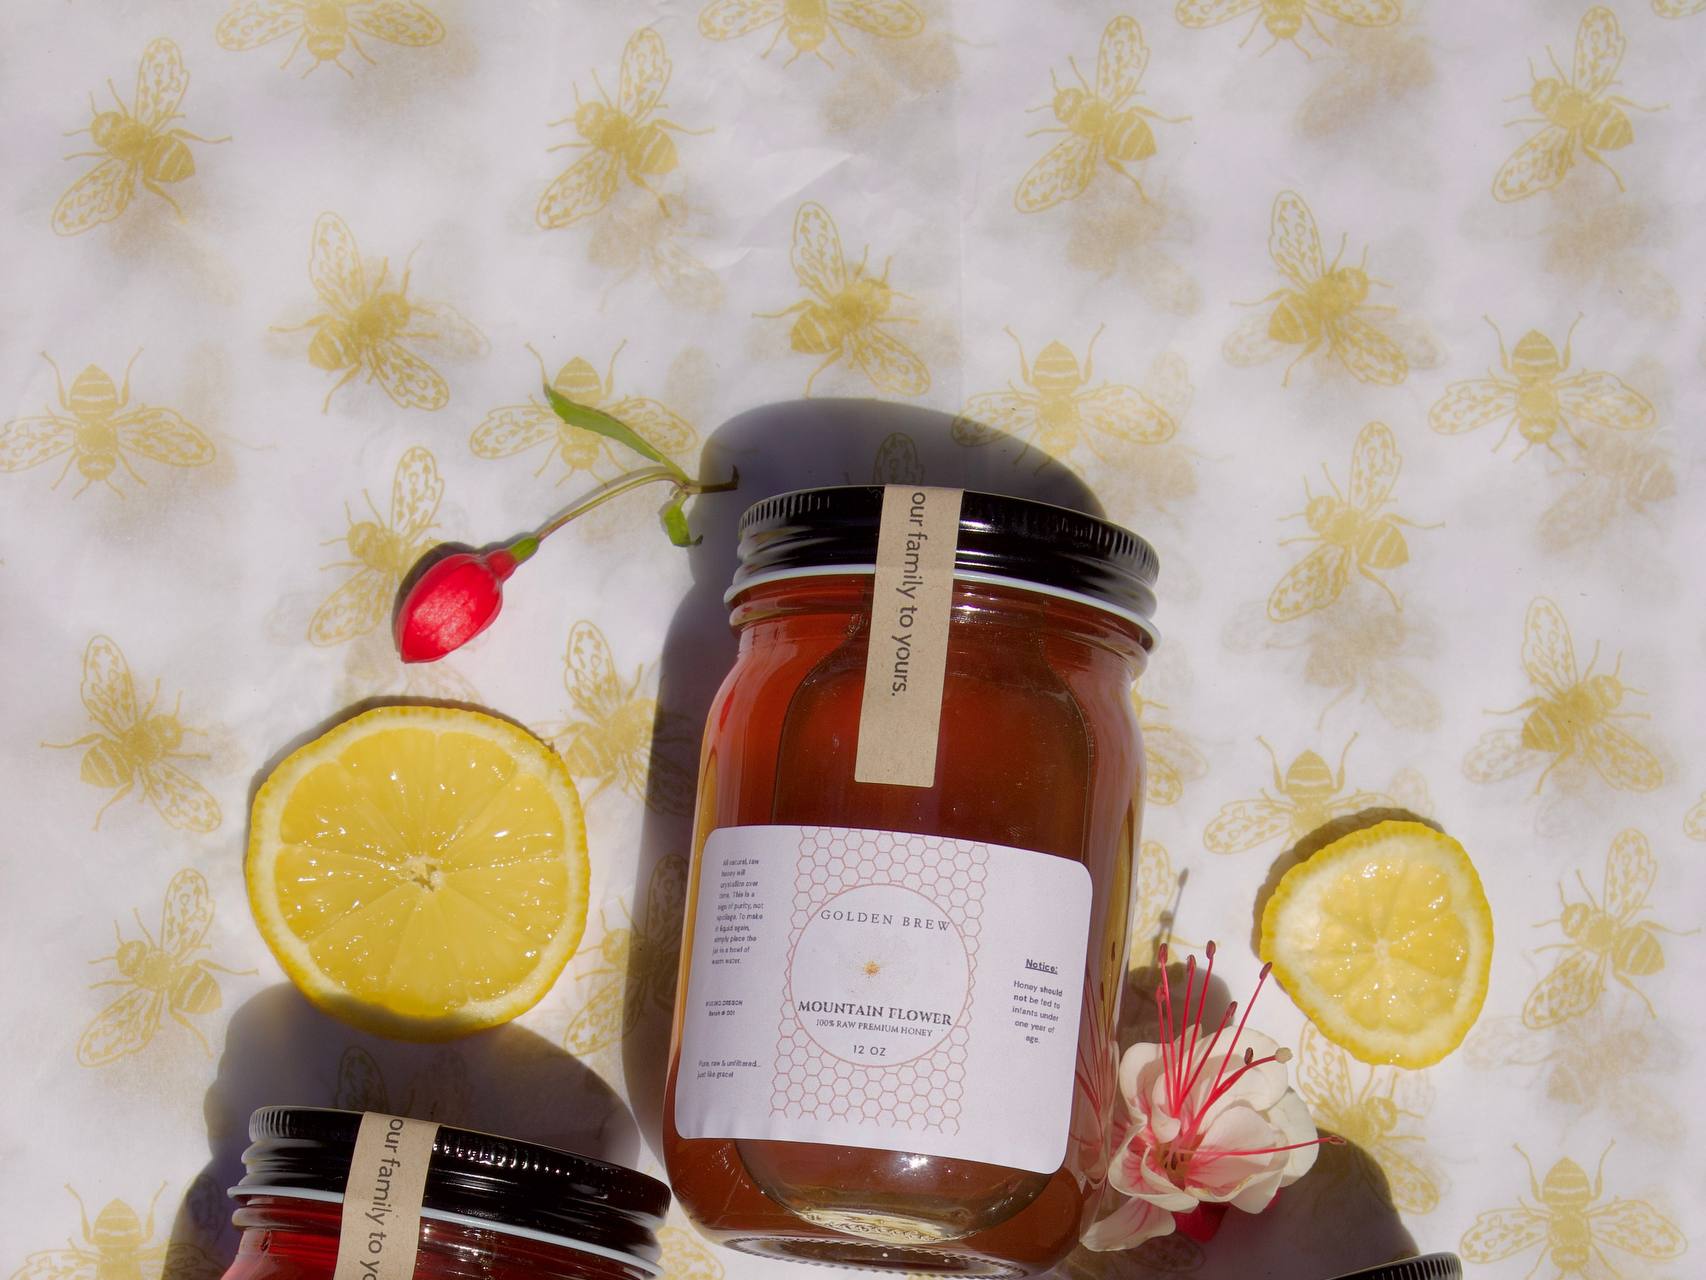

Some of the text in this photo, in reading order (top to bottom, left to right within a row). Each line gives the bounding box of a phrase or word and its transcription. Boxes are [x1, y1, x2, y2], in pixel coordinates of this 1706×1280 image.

[892, 492, 928, 696] our family to yours.
[821, 910, 950, 931] GOLDEN BREW
[1025, 959, 1058, 975] Notice:
[1014, 980, 1063, 997] Honey should
[1029, 996, 1038, 1004] be
[1041, 998, 1052, 1007] fed
[798, 1001, 952, 1025] MOUNTAIN FLOWER
[1013, 1007, 1058, 1021] infants under
[816, 1019, 932, 1037] 100% RAW PREMIUM HONEY
[853, 1045, 886, 1056] 12 OZ
[385, 1119, 403, 1153] our
[365, 1158, 400, 1225] family
[368, 1231, 386, 1253] to
